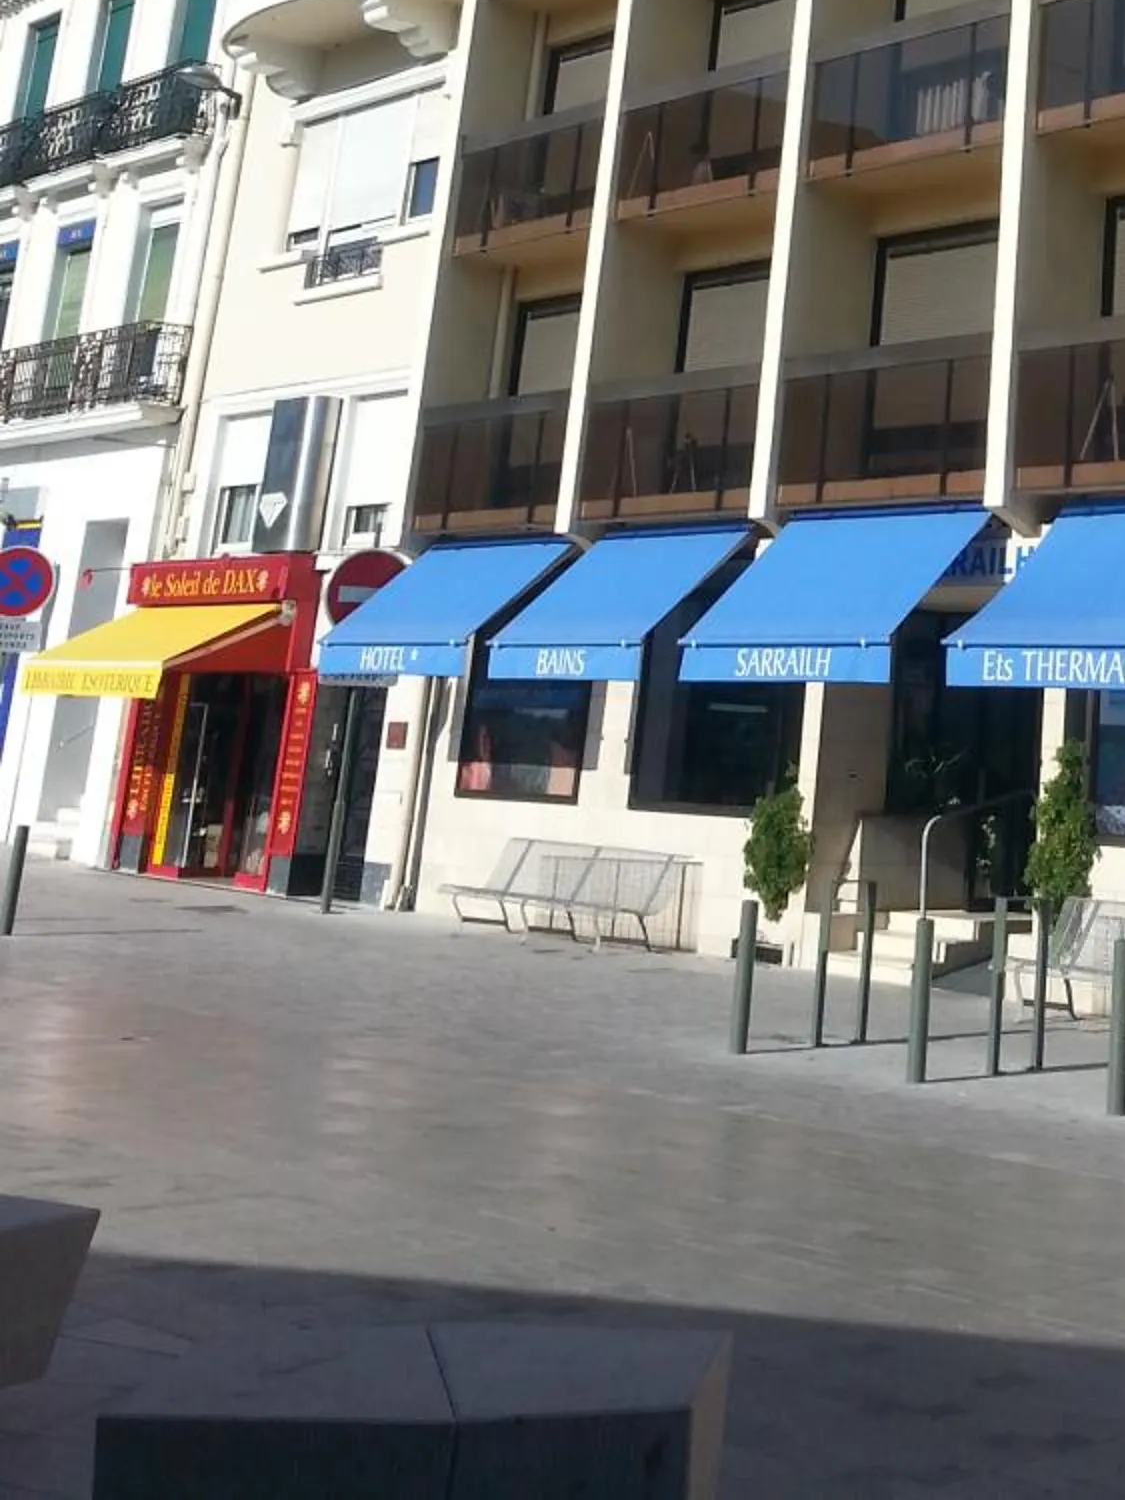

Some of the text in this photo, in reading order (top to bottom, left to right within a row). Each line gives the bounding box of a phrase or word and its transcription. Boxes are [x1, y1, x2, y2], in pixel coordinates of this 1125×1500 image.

[164, 570, 201, 597] Soleil
[202, 570, 221, 595] de
[222, 567, 258, 595] DAX
[359, 646, 405, 671] HOTEL
[535, 648, 586, 676] BAINS
[735, 647, 832, 678] SARRAILH
[982, 650, 1014, 682] Ets
